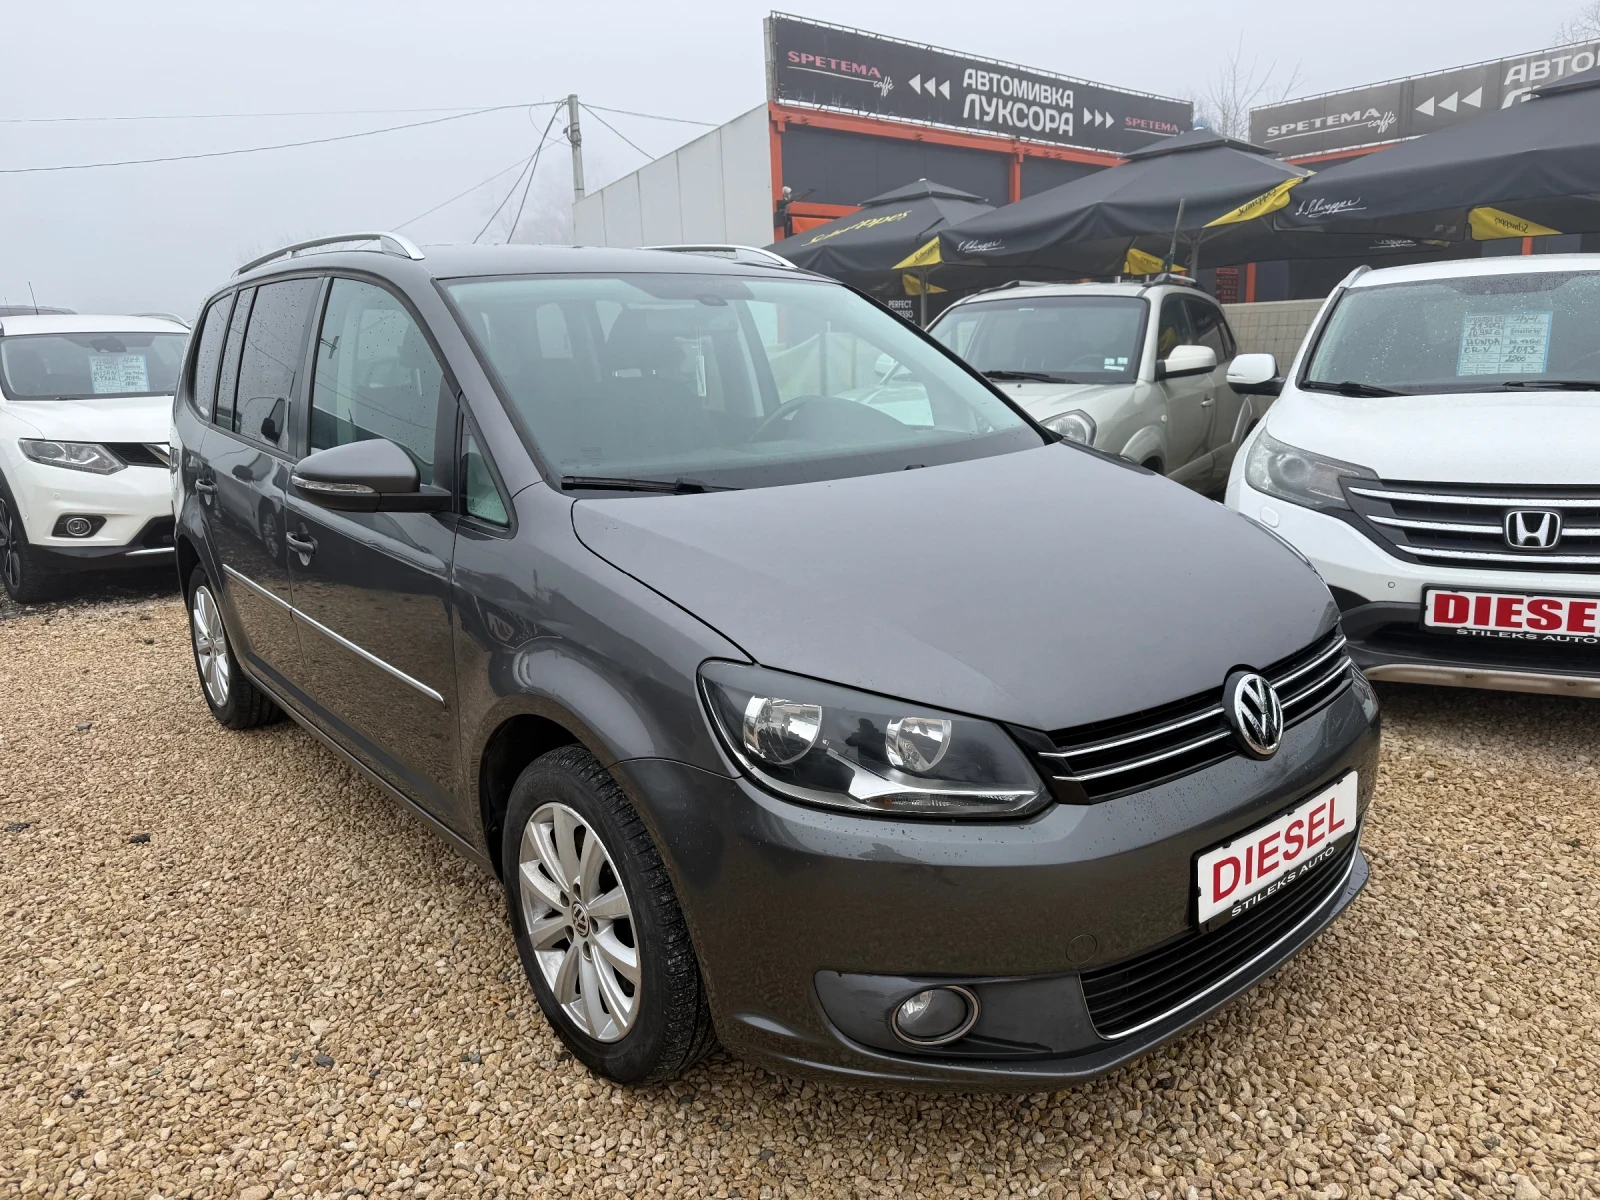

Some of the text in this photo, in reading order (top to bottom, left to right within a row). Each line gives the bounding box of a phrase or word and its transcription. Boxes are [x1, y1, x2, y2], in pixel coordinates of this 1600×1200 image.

[787, 50, 882, 78] SPETEMA
[1504, 50, 1600, 85] АВТО
[963, 68, 1074, 109] АВТОМИВКА
[963, 93, 1074, 137] ЛУКСОРА
[1125, 116, 1179, 133] SPETEMA
[1266, 107, 1381, 138] SPETEMA
[801, 210, 912, 247] Schweppes
[888, 300, 912, 308] PERFECT
[1464, 345, 1492, 354] CR-V
[1465, 337, 1501, 346] HONDA
[1433, 593, 1600, 633] DIESE
[1456, 628, 1598, 644] STILEKS AUTO
[1213, 797, 1345, 904] DIESEL
[1231, 846, 1335, 917] STILEKS AUTO
